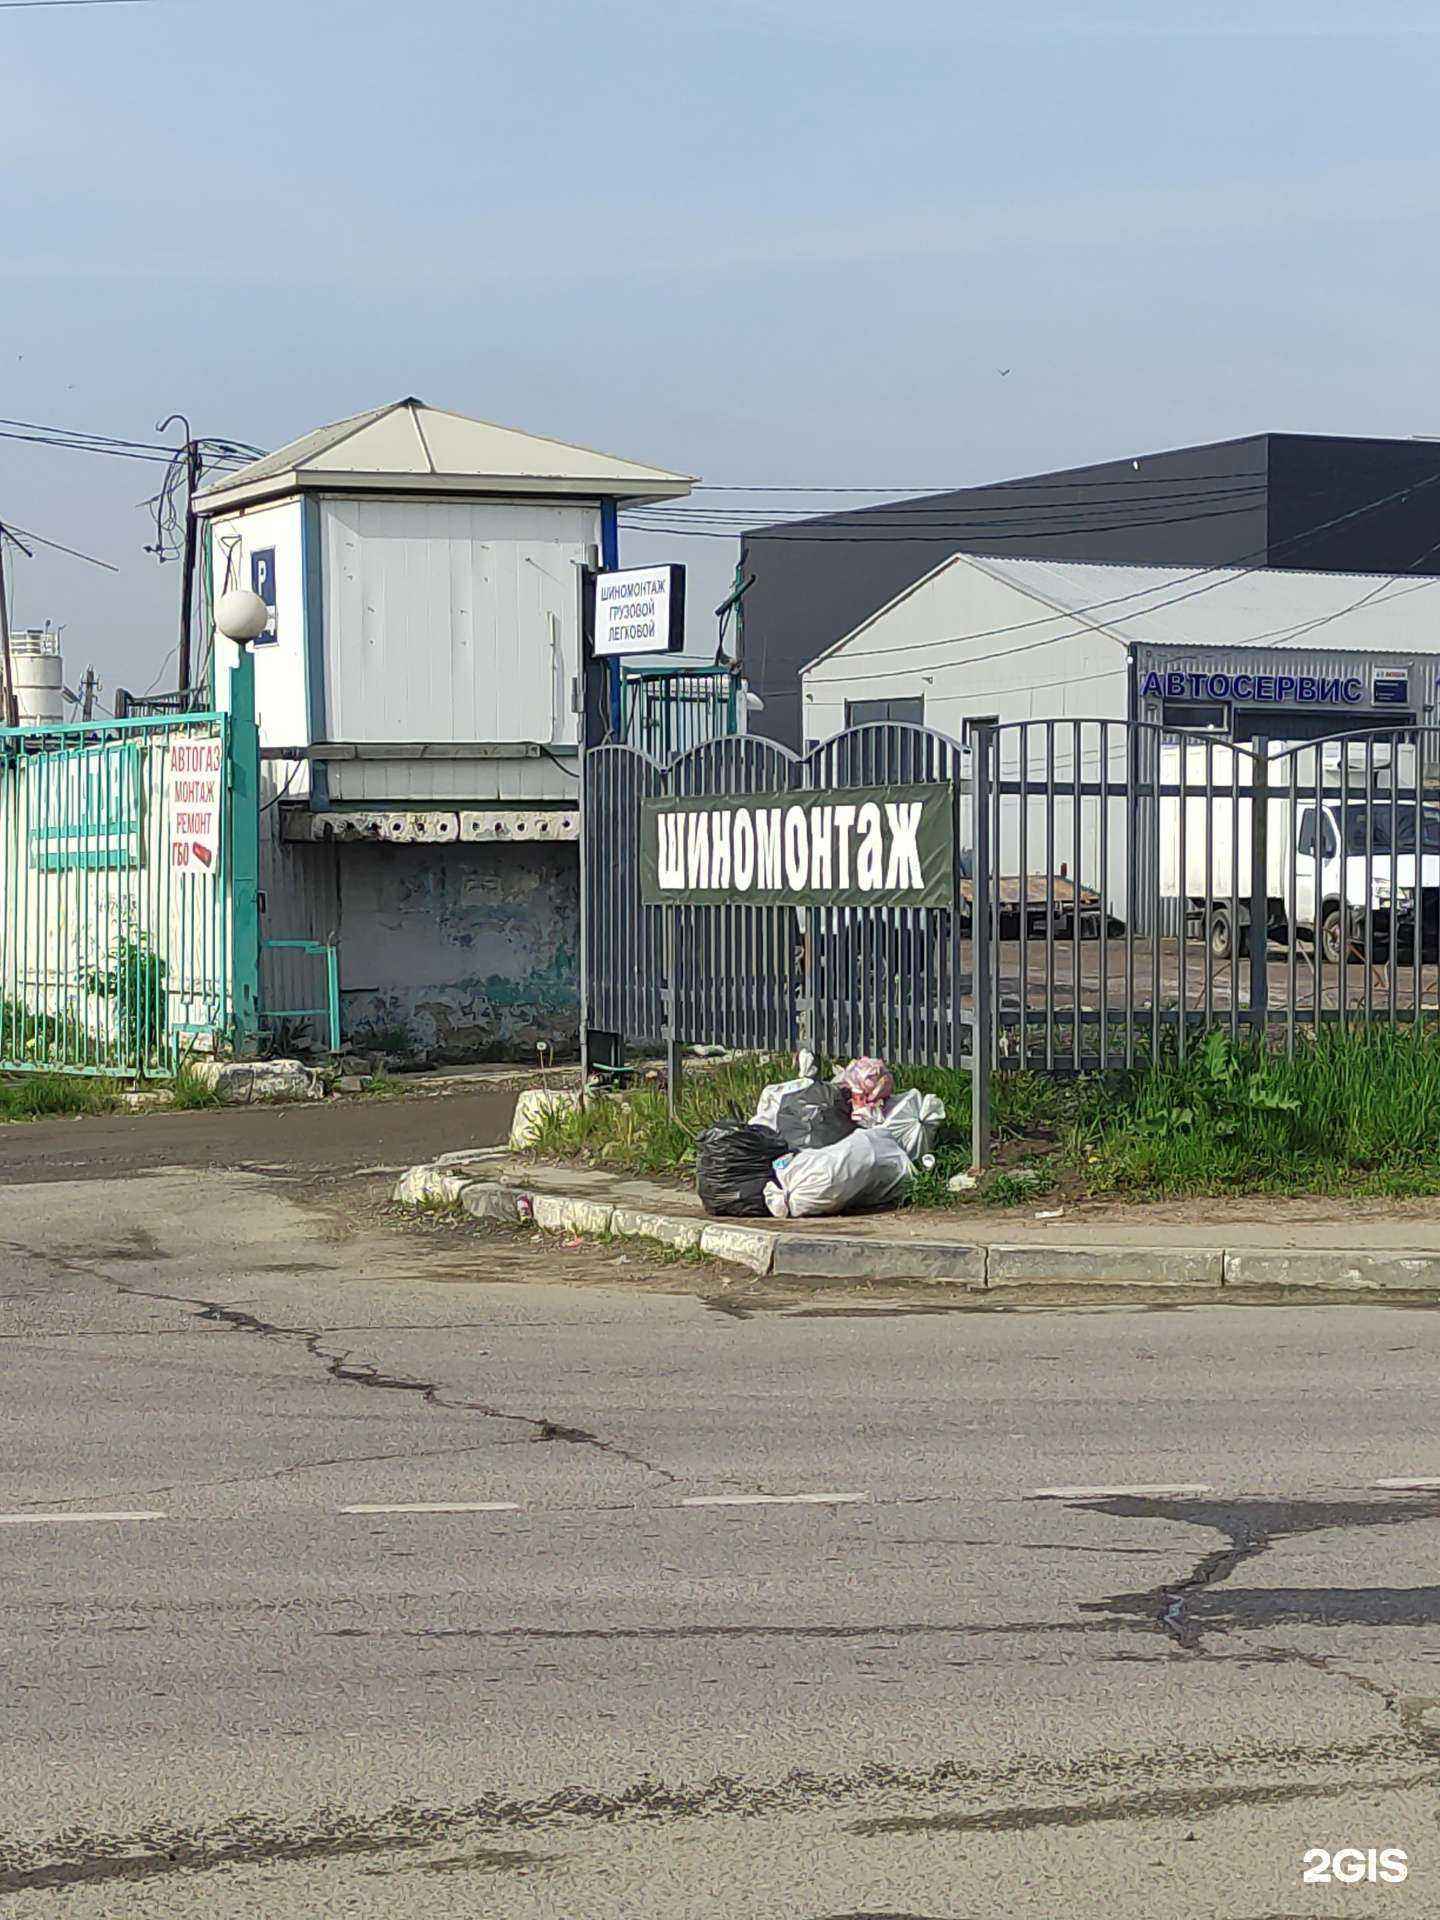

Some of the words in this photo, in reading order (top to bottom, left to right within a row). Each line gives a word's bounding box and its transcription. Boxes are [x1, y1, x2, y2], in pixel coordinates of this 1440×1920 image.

[601, 580, 666, 601] ШИНОМОНТАЖ
[609, 599, 655, 621] ГРУЗОВОЙ
[608, 619, 656, 641] ЛЕГКОВОЙ
[1140, 671, 1364, 705] АВТОСЕРВИС
[171, 745, 221, 773] АВТОГАЗ
[174, 780, 215, 803] МОНТАЖ
[176, 812, 212, 835] РЕМОНТ
[172, 842, 189, 866] ГБО
